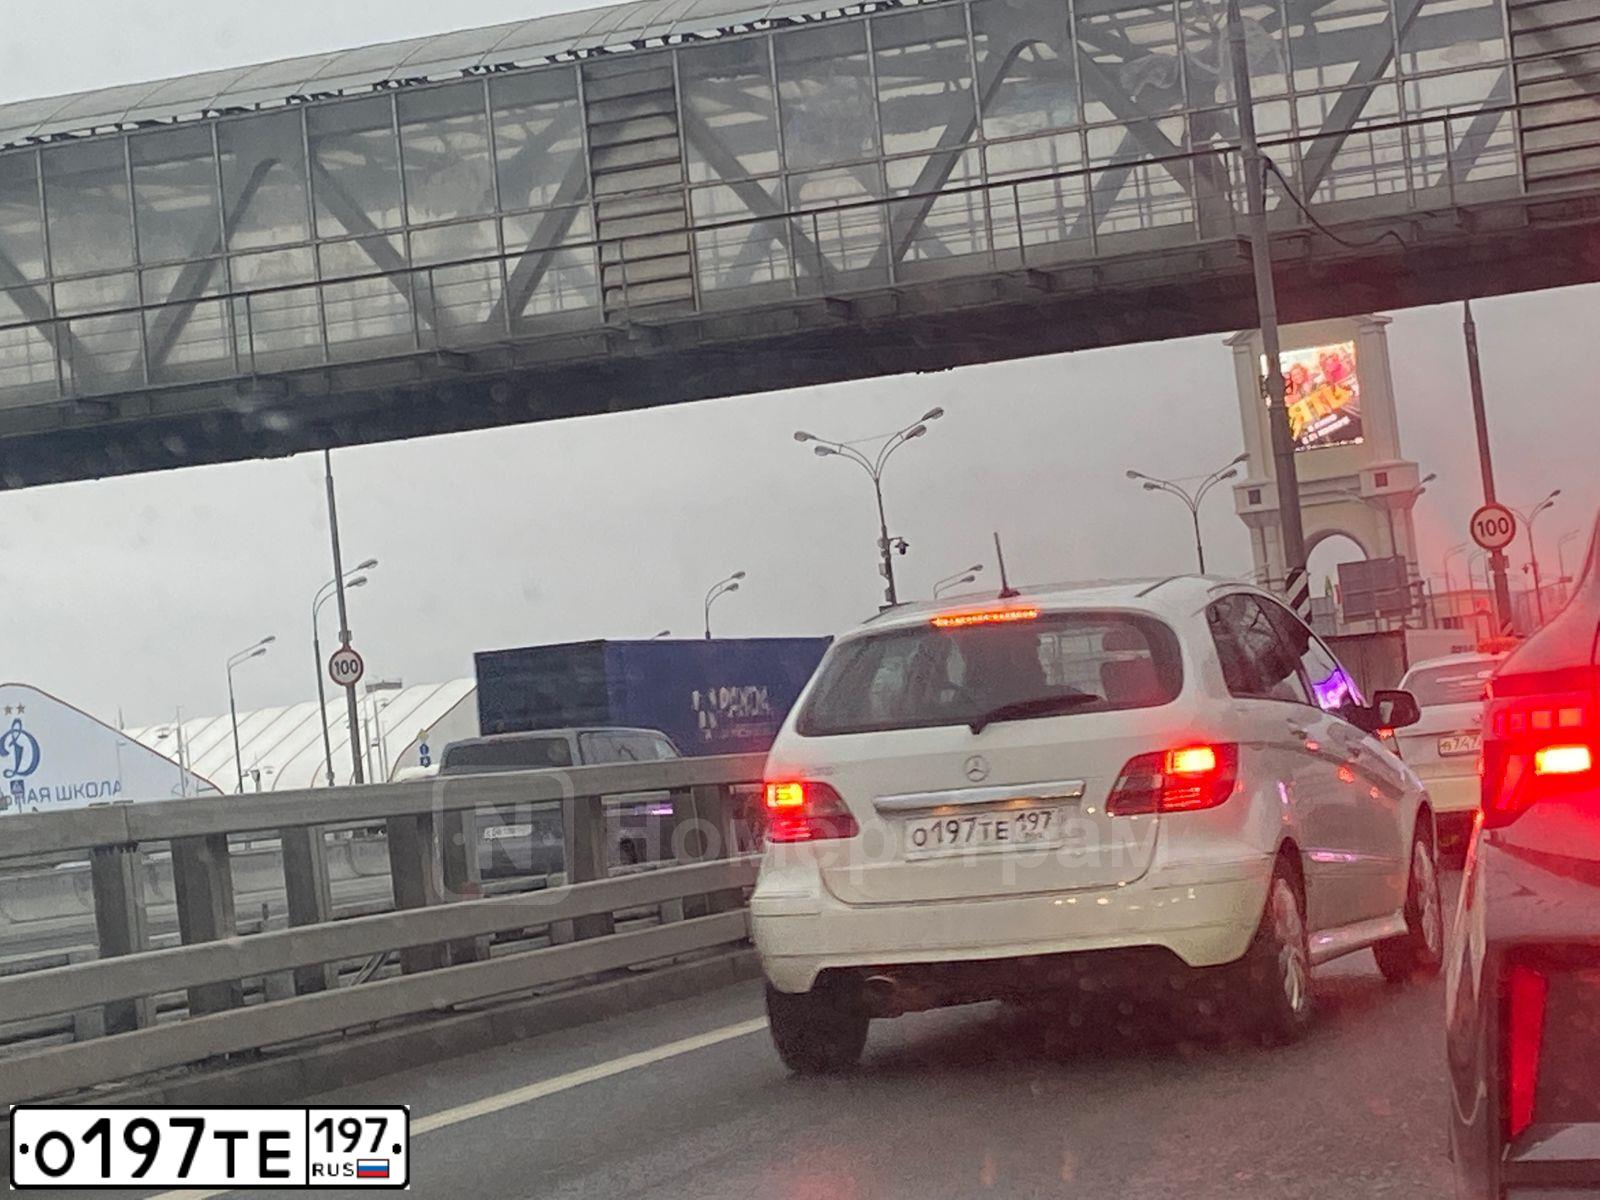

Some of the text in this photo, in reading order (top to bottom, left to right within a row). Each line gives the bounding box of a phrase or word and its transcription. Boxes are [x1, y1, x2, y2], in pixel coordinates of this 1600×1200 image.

[1477, 517, 1509, 537] 100
[335, 659, 359, 676] 100
[55, 780, 121, 801] ШКОЛА
[1016, 811, 1052, 830] 197
